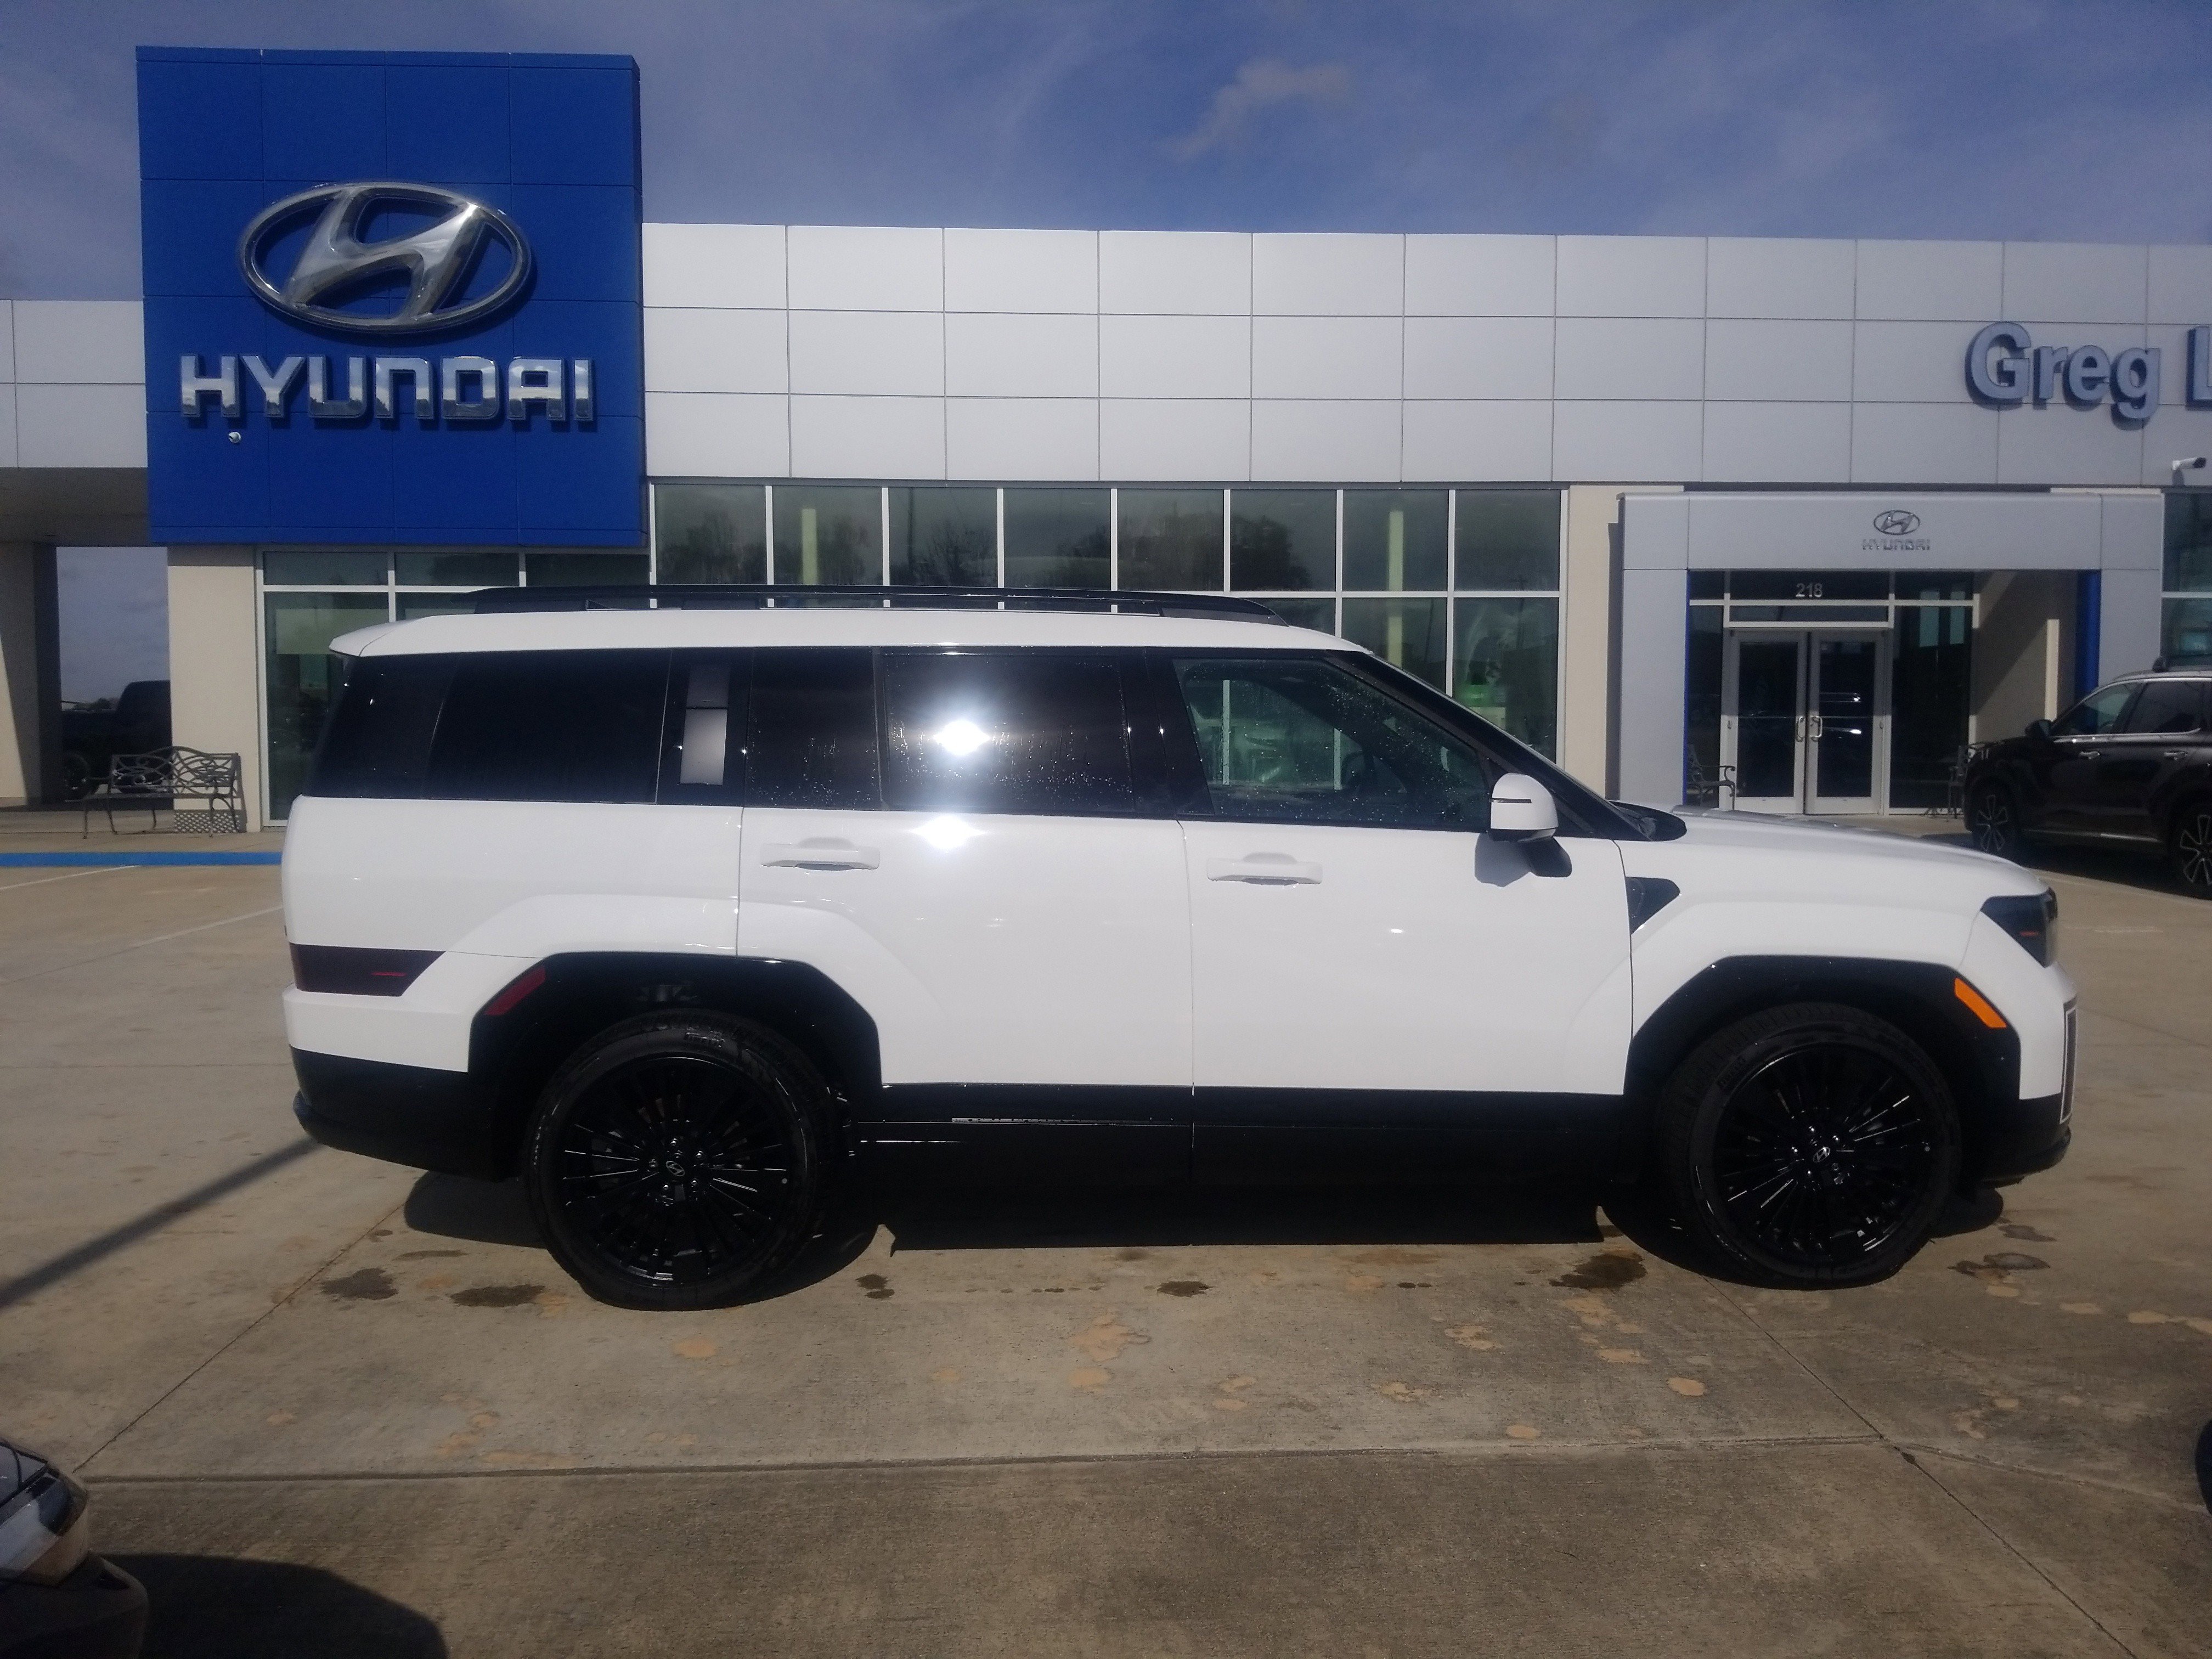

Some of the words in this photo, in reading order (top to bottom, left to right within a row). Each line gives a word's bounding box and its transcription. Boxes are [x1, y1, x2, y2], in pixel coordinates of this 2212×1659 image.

[180, 354, 595, 421] HYUNDAI
[1968, 321, 2160, 419] Greg
[1862, 539, 1931, 550] HYUNDAI
[1796, 583, 1822, 597] 218
